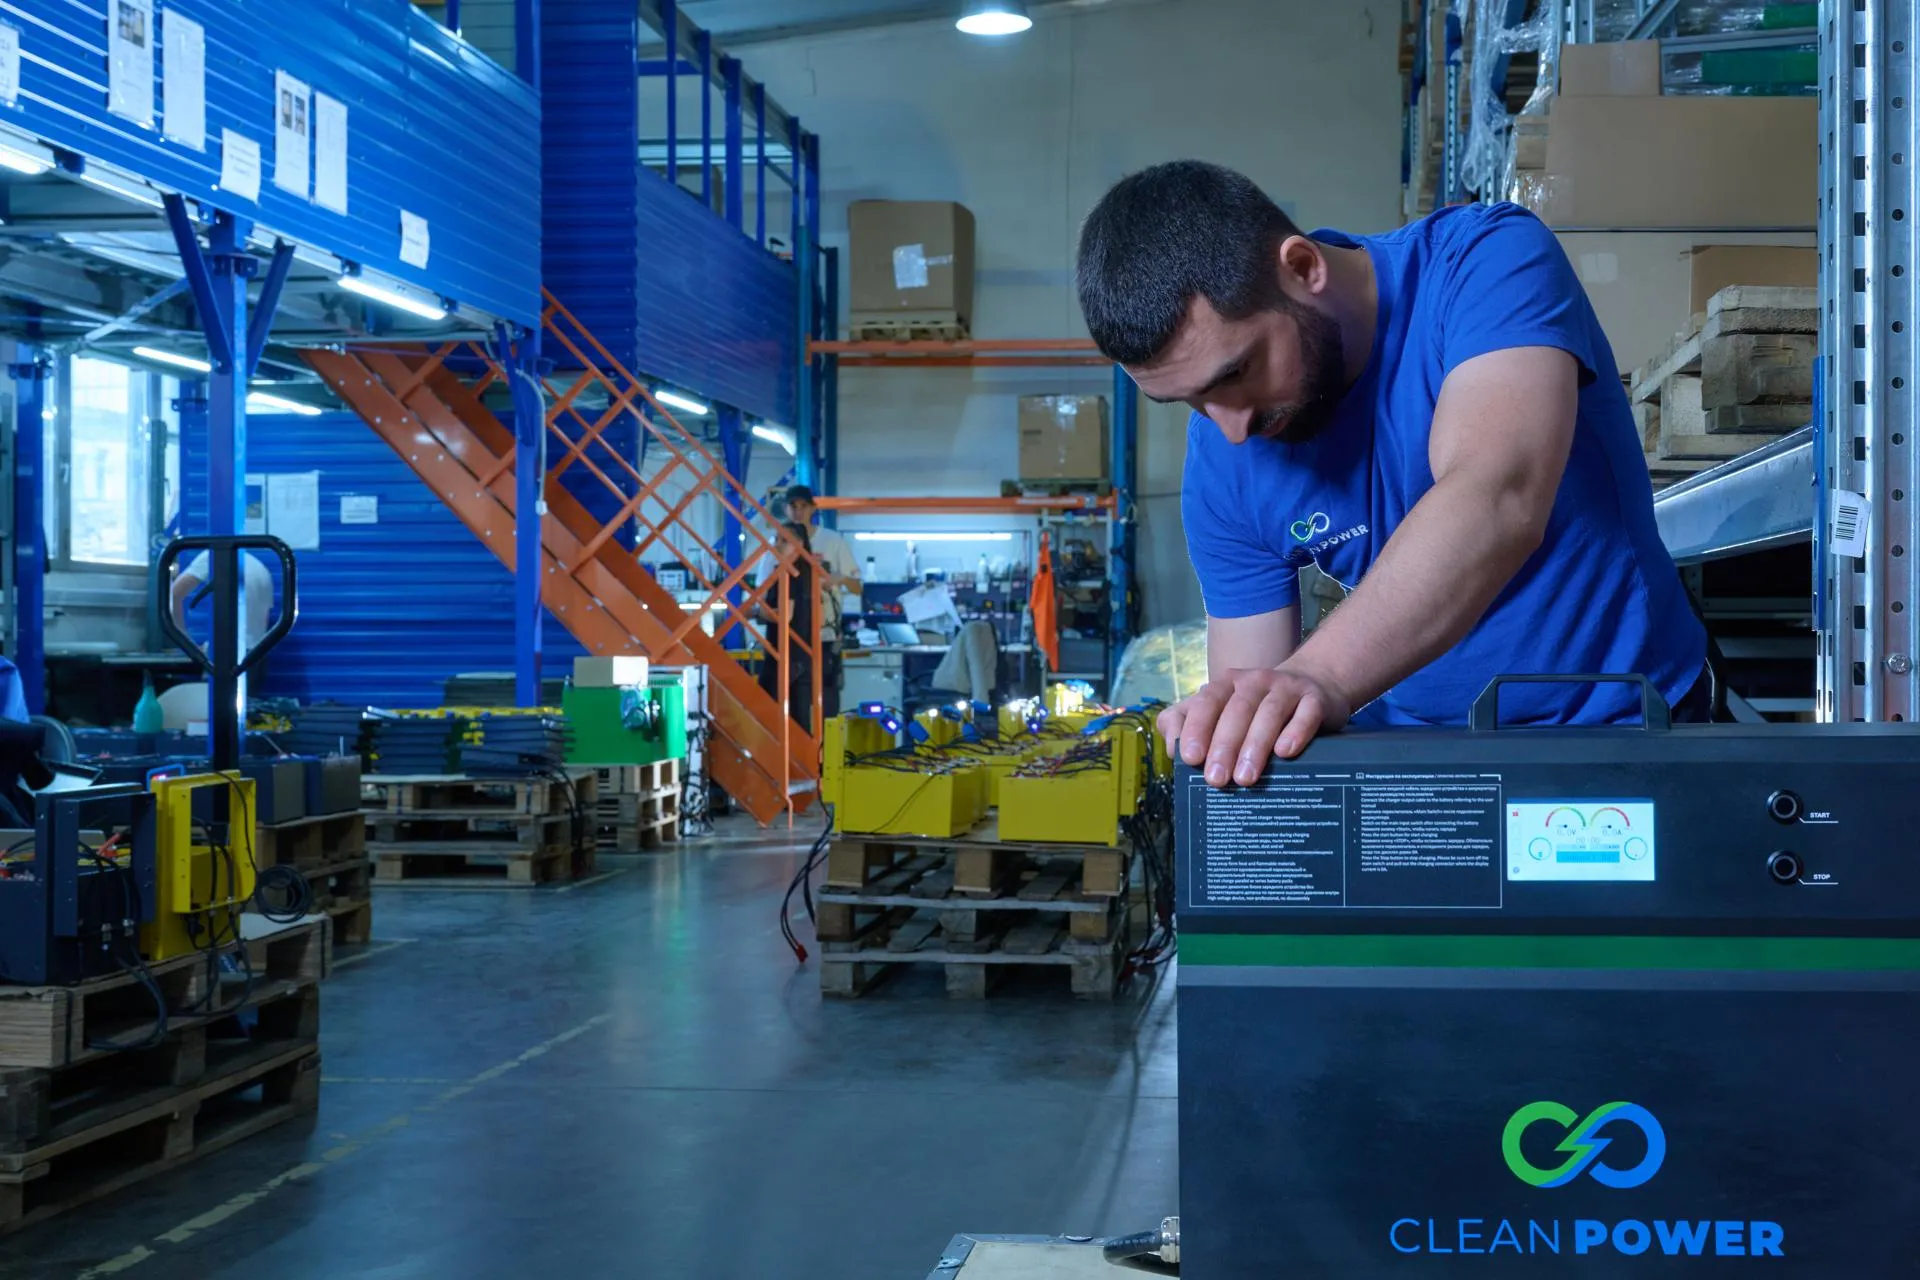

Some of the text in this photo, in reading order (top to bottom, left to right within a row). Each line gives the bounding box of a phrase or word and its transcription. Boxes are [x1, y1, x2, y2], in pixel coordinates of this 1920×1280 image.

[1320, 524, 1369, 550] POWER
[1389, 1217, 1785, 1257] CLEAN POWER
